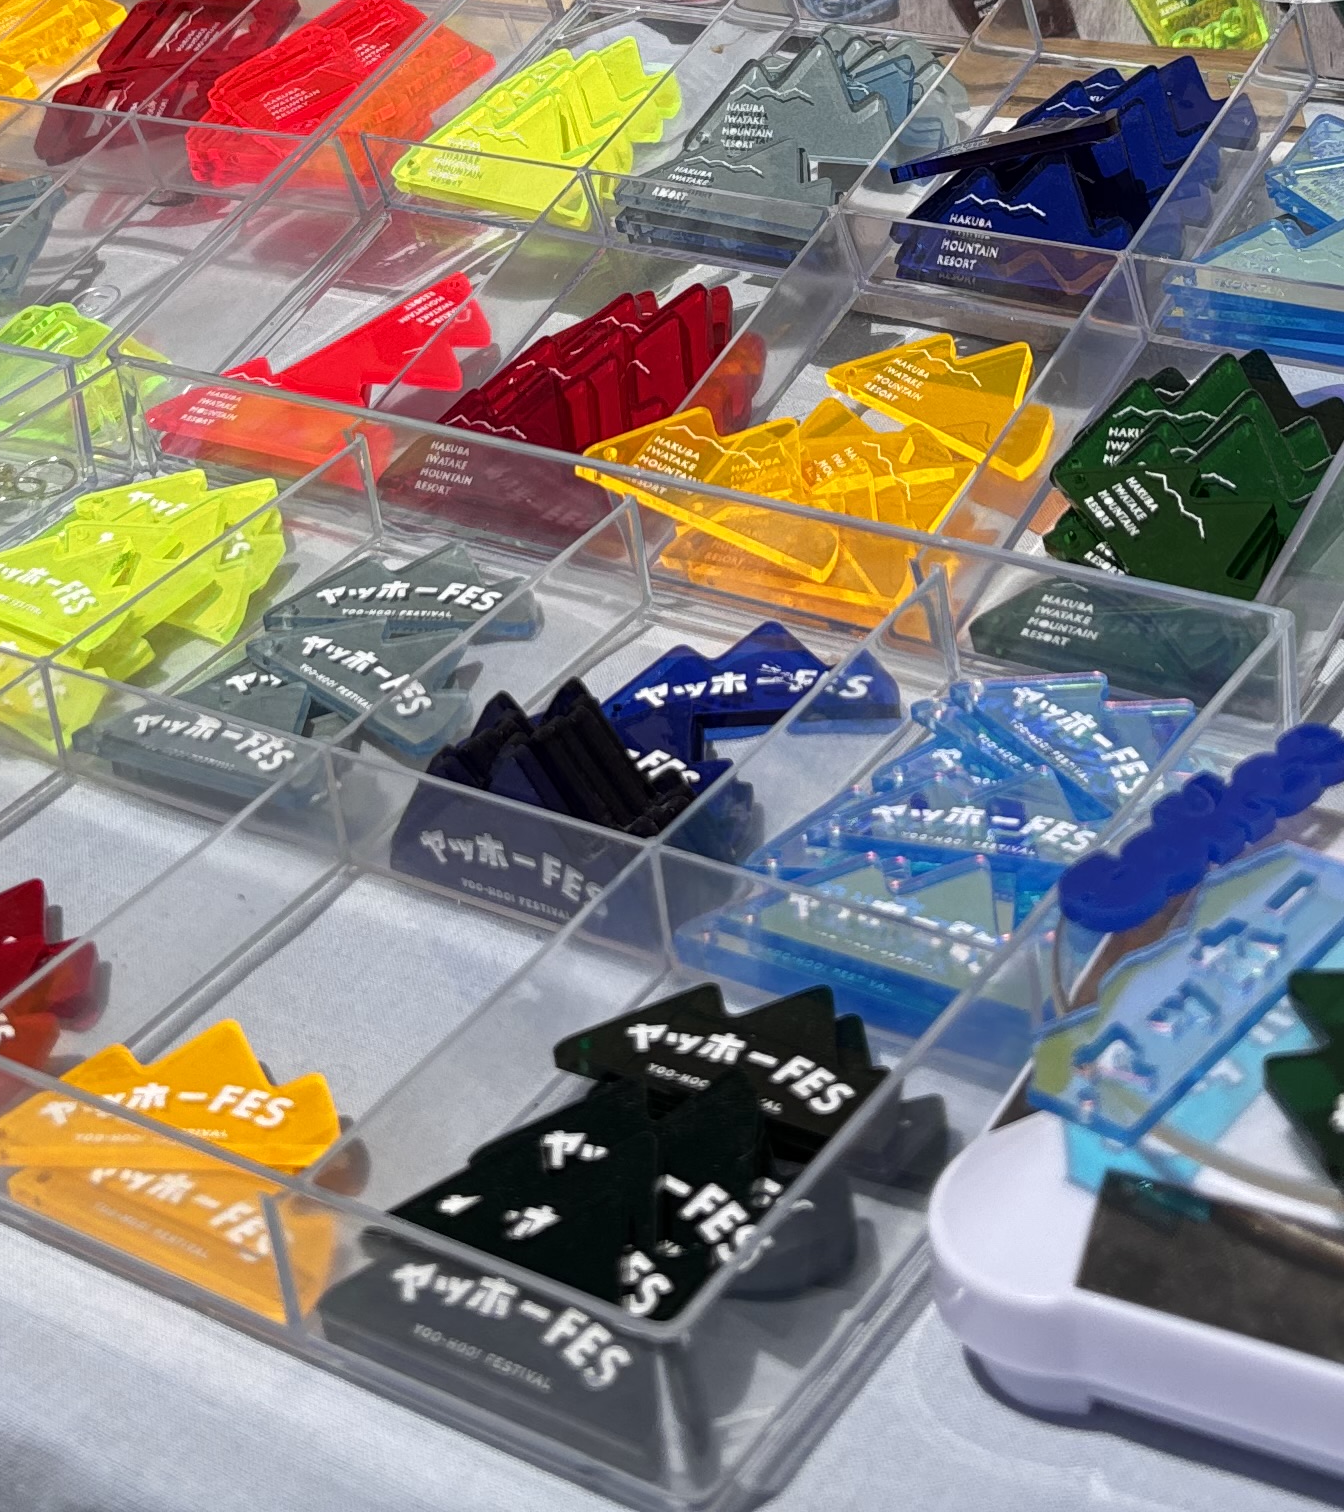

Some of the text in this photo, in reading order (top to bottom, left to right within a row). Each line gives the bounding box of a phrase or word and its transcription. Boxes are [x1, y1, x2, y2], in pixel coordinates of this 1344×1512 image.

[726, 102, 765, 113] HAKUBA
[722, 126, 774, 138] MOUNTAIN
[724, 116, 765, 125] IWATAKE
[674, 166, 713, 178] HAKUBA
[950, 213, 992, 229] HAKUBA
[940, 238, 1000, 259] MOUNTAIN
[936, 254, 978, 271] RESORT
[883, 365, 925, 390] IWATAKE
[893, 356, 930, 380] HAKUBA
[206, 388, 243, 404] HAKUBA
[863, 380, 899, 403] RESORT
[873, 373, 924, 402] MOUNTAIN
[198, 396, 239, 412] IWATAKE
[430, 440, 470, 458] HAKUBA
[646, 443, 697, 473] IWATAKE
[654, 434, 701, 462] HAKUBA
[426, 452, 470, 472] IWATAKE
[414, 479, 452, 497] RESORT
[420, 466, 474, 487] MOUNTAIN
[1111, 482, 1149, 523] IWATAKE
[1125, 475, 1159, 514] HAKUBA
[1083, 496, 1115, 532] RESORT
[1097, 489, 1141, 539] MOUNTAIN
[316, 580, 505, 612] ヤッホーFES
[1042, 593, 1095, 613] HAKUBA
[399, 609, 453, 620] FESTIVAL
[1034, 604, 1094, 628] IWATAKE
[1020, 628, 1071, 647] RESORT
[1026, 616, 1098, 641] MOUNTAIN
[133, 713, 295, 772] ヤッホーFES
[871, 803, 1103, 854] ヤッホーFES
[419, 827, 610, 918] ヤッホーFES
[625, 1021, 856, 1114] ヤッホーFES
[390, 1262, 632, 1389] ヤッホーFES
[413, 1322, 553, 1393] YOO-HOO! FESTIVAL
